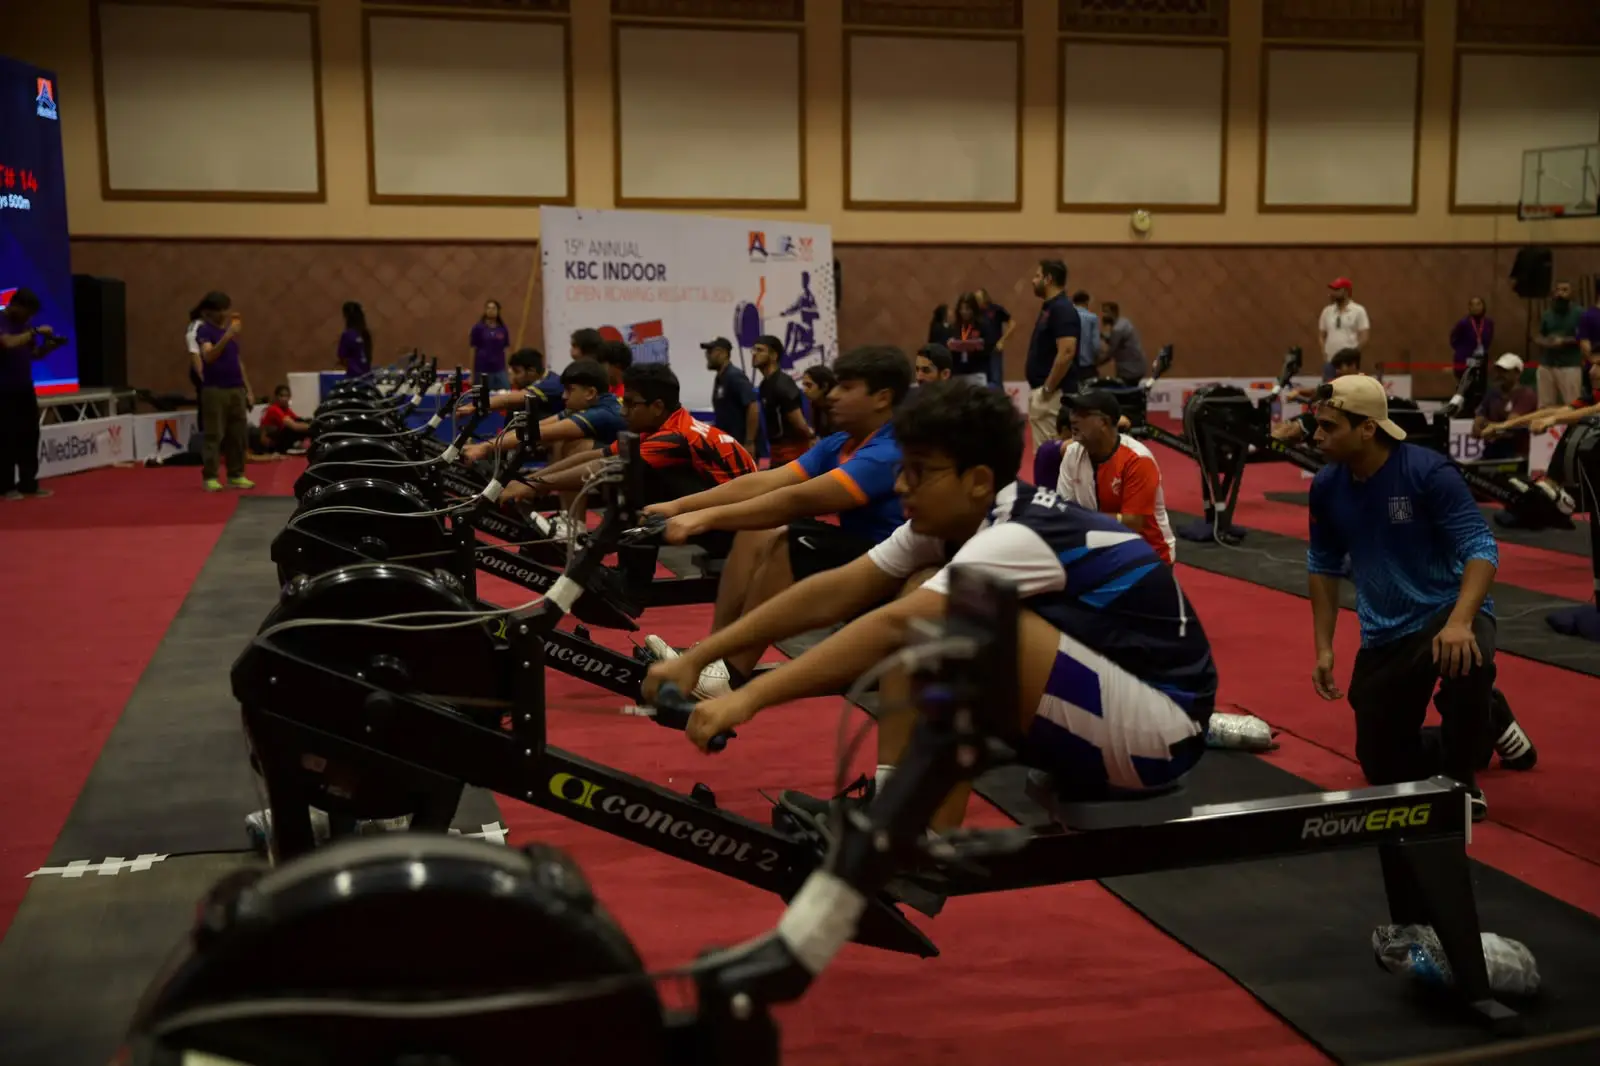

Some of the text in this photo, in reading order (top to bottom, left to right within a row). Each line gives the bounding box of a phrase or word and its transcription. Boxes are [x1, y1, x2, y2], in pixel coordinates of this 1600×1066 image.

[19, 168, 38, 193] 14
[9, 194, 31, 210] 500m
[564, 239, 644, 259] 15th ANNUAL
[564, 260, 667, 282] KBC INDOOR
[565, 285, 602, 302] OPEN
[604, 285, 656, 303] ROWING
[657, 285, 709, 303] REGATTA
[543, 639, 633, 685] ncept 2
[601, 794, 781, 873] concept 2
